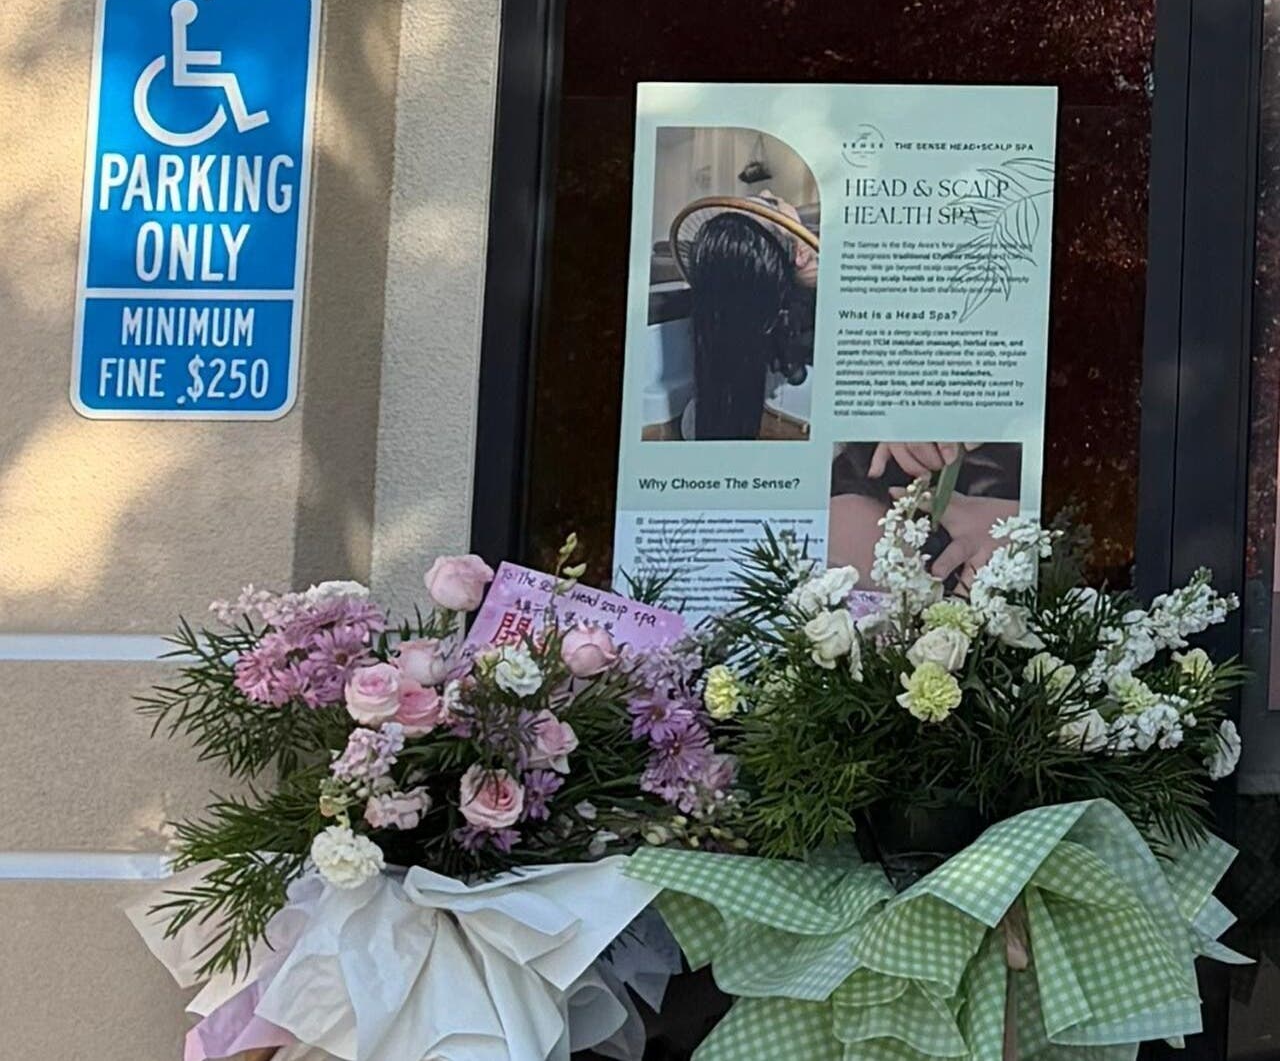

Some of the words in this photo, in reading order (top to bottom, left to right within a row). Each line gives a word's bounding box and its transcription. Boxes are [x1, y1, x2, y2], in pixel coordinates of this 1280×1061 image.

[99, 153, 295, 213] PARKING
[844, 178, 907, 198] HEAD
[912, 178, 933, 198] &
[938, 178, 1009, 198] SCALP
[844, 206, 932, 226] HEALTH
[938, 206, 978, 226] SPA
[136, 221, 252, 282] ONLY
[122, 306, 255, 347] MINIMUM
[838, 310, 868, 321] What
[871, 310, 882, 321] is
[885, 310, 892, 321] a
[896, 310, 926, 321] Head
[929, 310, 958, 321] Spa?
[100, 358, 166, 398] FINE
[186, 354, 269, 401] $250
[638, 478, 668, 492] Why
[671, 478, 722, 490] Choose
[724, 478, 749, 490] The
[752, 478, 801, 490] Sense?
